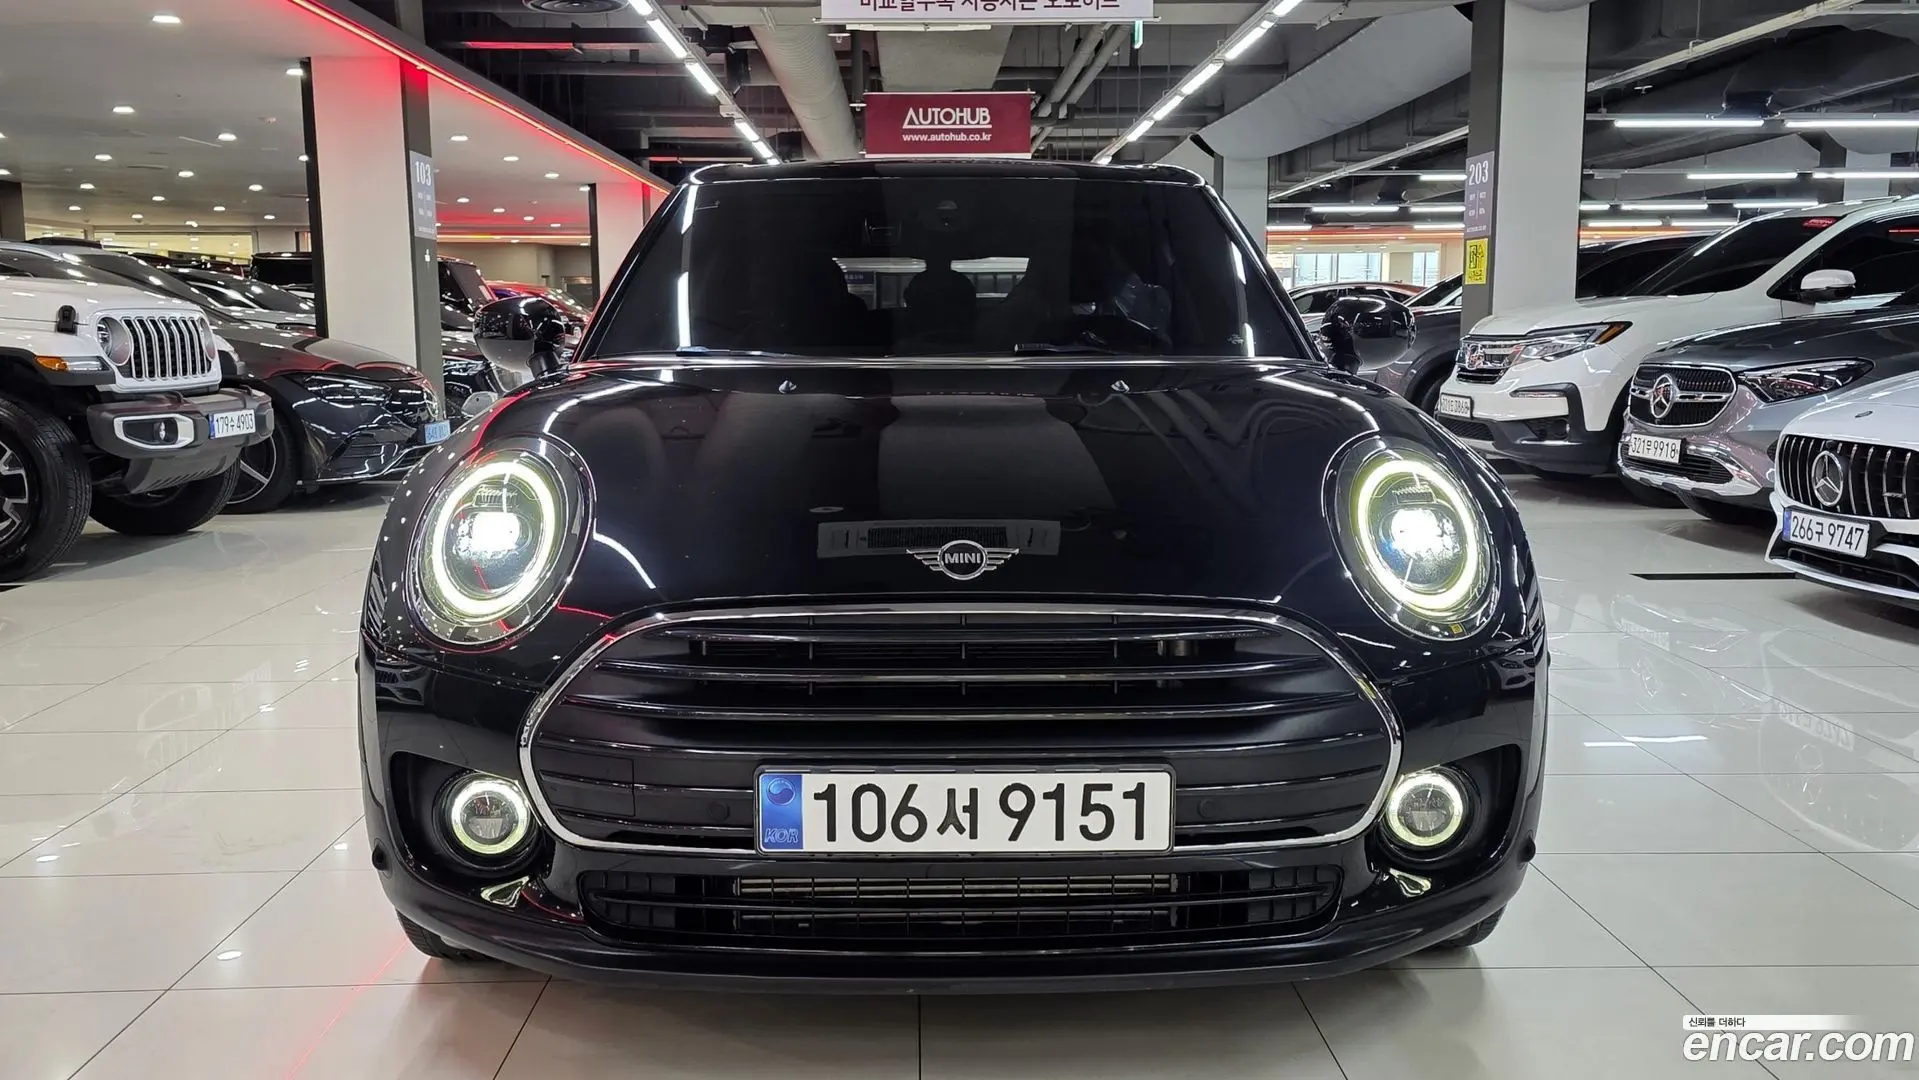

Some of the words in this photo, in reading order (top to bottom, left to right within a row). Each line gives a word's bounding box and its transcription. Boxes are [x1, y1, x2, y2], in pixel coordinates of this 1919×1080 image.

[902, 107, 991, 129] AUTOHUB
[902, 132, 992, 142] www.autohub.co.kr
[415, 160, 431, 186] 103
[1468, 160, 1489, 186] 203
[1653, 440, 1677, 459] 9918
[1791, 515, 1824, 543] 266구
[1827, 522, 1865, 551] 9747
[944, 552, 981, 565] MINI
[813, 782, 979, 843] 106서
[999, 781, 1146, 842] 9151
[764, 828, 799, 843] KOR
